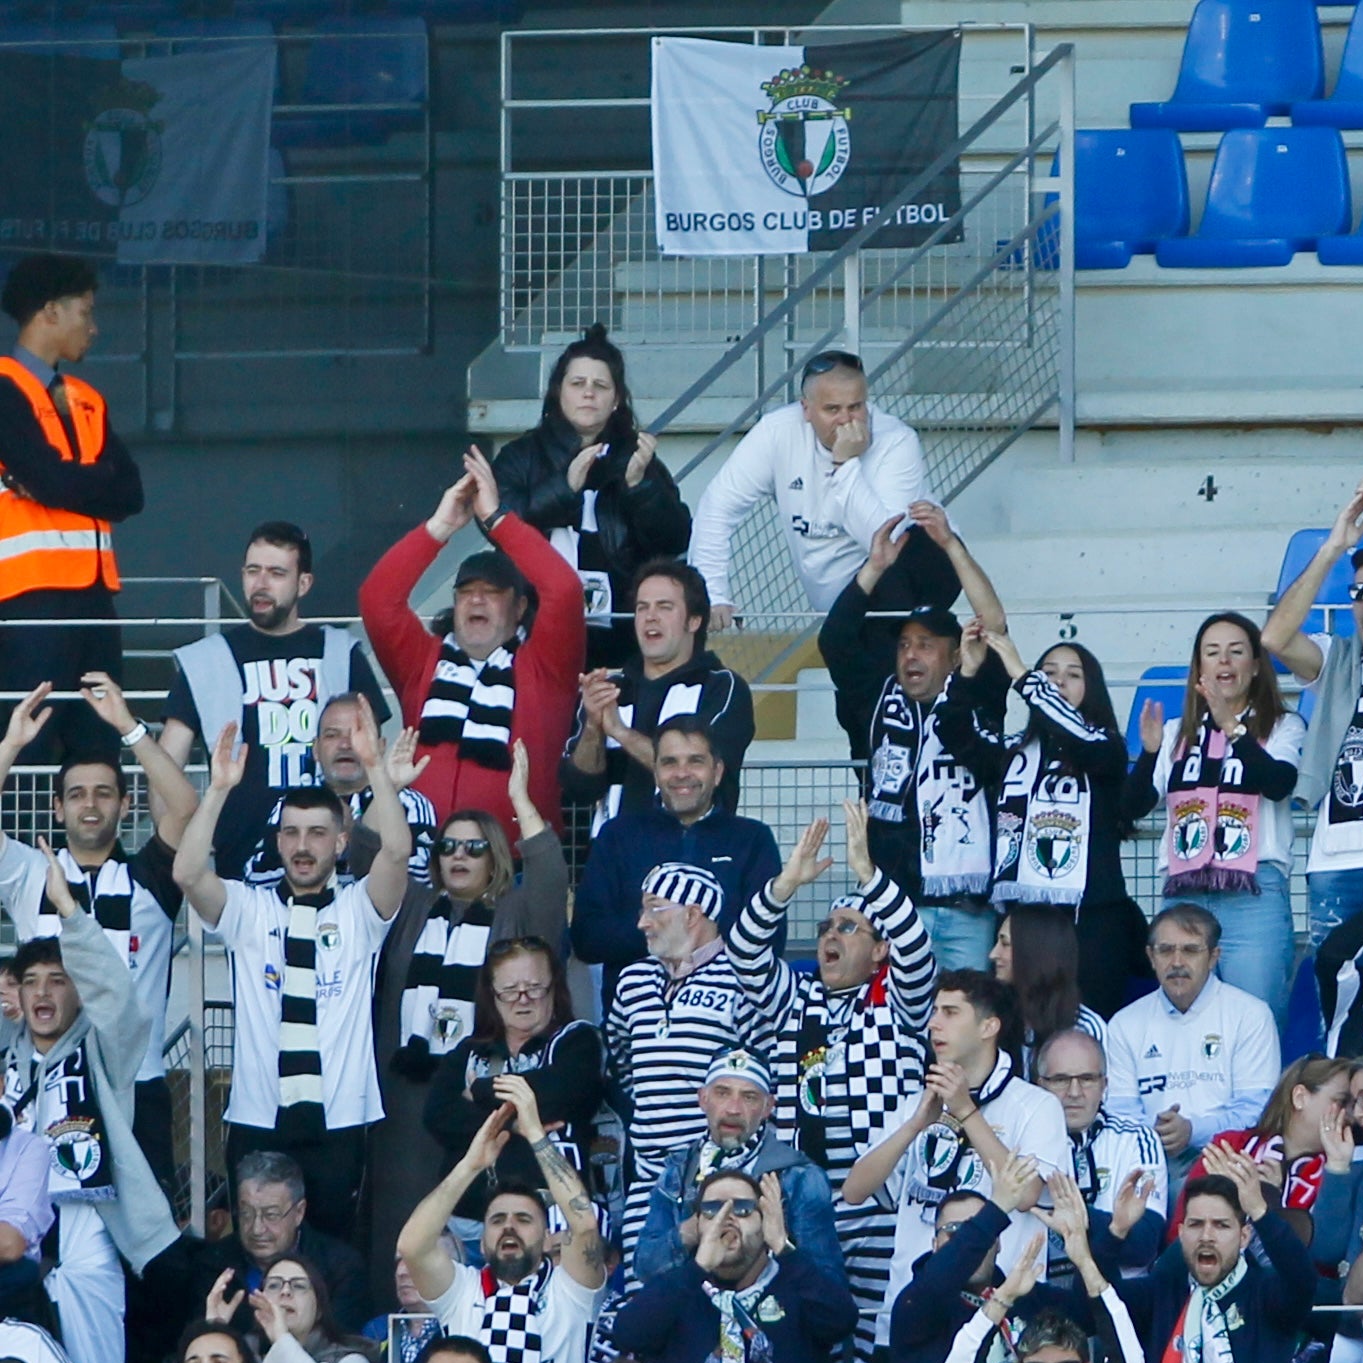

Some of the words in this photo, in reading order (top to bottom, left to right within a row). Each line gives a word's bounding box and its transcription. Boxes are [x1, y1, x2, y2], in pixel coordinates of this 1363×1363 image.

[787, 98, 819, 110] CLUB
[763, 127, 788, 185] BURGOS
[826, 127, 849, 180] FUTBOL
[666, 212, 756, 233] BURGOS
[763, 210, 823, 231] CLUB
[828, 208, 857, 230] DE
[862, 203, 951, 227] FTBOL
[1196, 473, 1219, 502] 4
[1057, 614, 1078, 640] 3
[242, 657, 326, 704] JUST
[257, 699, 318, 747] DO
[677, 988, 728, 1012] 4852
